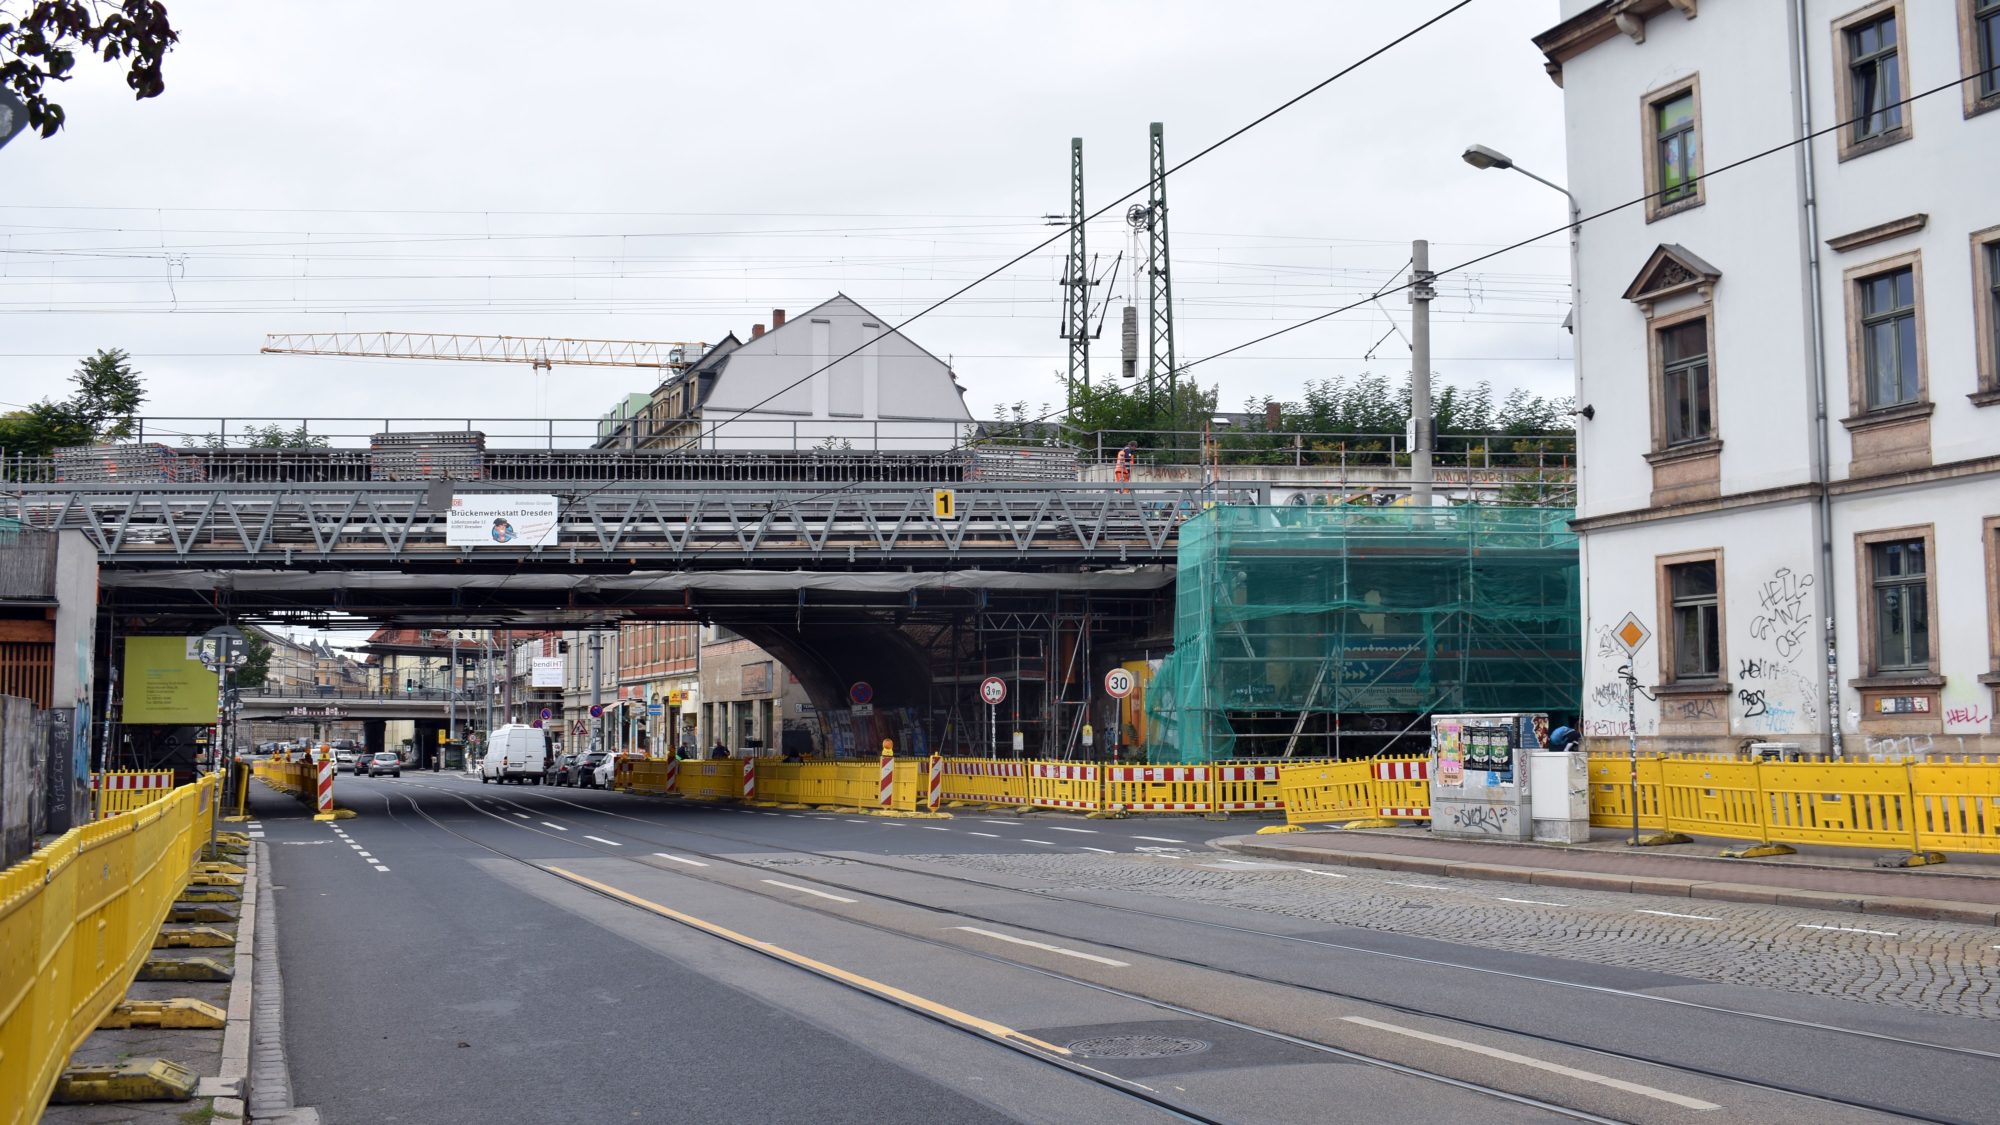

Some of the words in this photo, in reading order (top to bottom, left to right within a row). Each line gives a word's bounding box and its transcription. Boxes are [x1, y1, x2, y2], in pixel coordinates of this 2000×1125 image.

[939, 494, 949, 514] 1
[451, 509, 518, 517] Brückenwerkstatt
[520, 509, 553, 517] Dresden
[1111, 676, 1128, 690] 30
[1946, 704, 1988, 725] HELL
